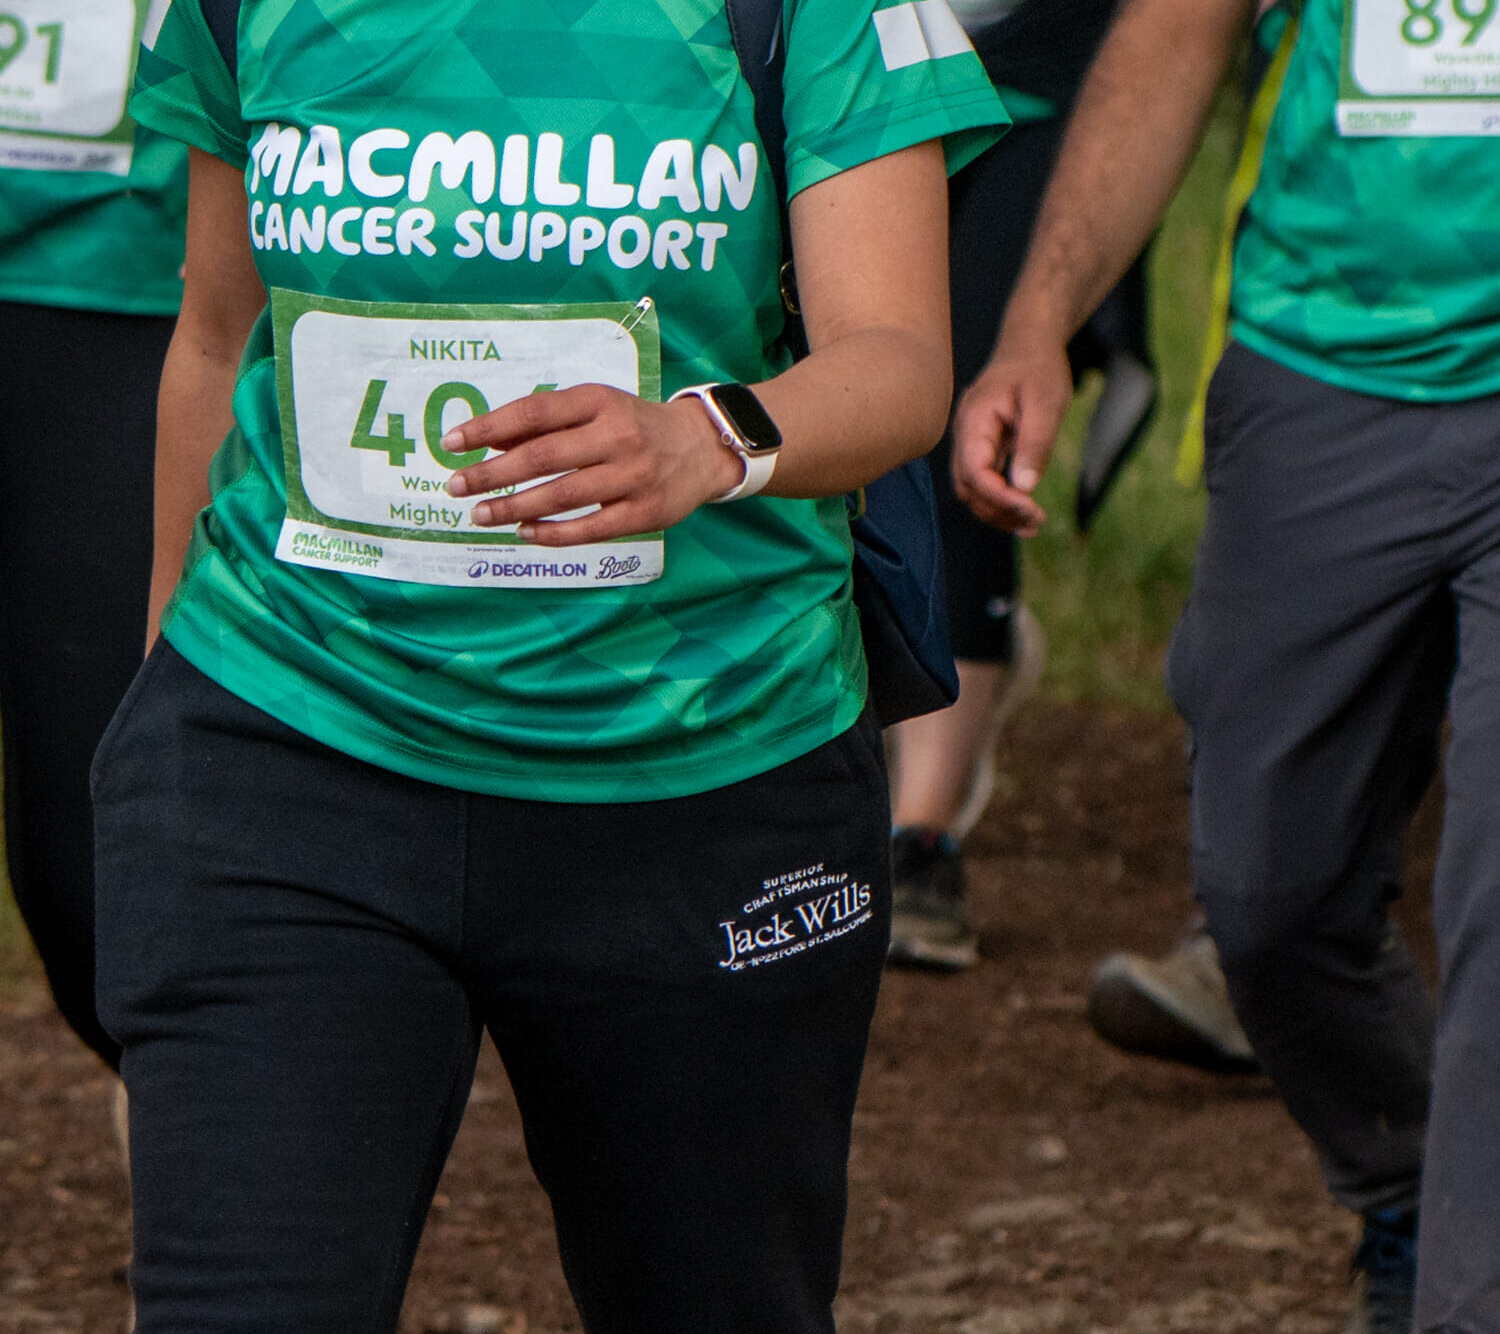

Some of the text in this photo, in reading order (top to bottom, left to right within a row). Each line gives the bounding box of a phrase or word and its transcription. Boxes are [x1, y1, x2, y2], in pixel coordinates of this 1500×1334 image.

[250, 121, 757, 213] MACMILLAN
[250, 200, 729, 272] CANCER SUPPORT
[409, 339, 502, 361] NIKITA
[349, 378, 558, 470] 40
[389, 502, 463, 528] Mighty
[291, 545, 380, 569] CANCER SUPPORT
[292, 531, 383, 559] MACMILLAN
[491, 563, 588, 578] DECATHLON
[595, 555, 641, 579] Boots
[762, 862, 824, 890] SUPERIOR
[743, 872, 849, 914] CRAFTSMANSHIP
[718, 881, 872, 968] Jack Wills
